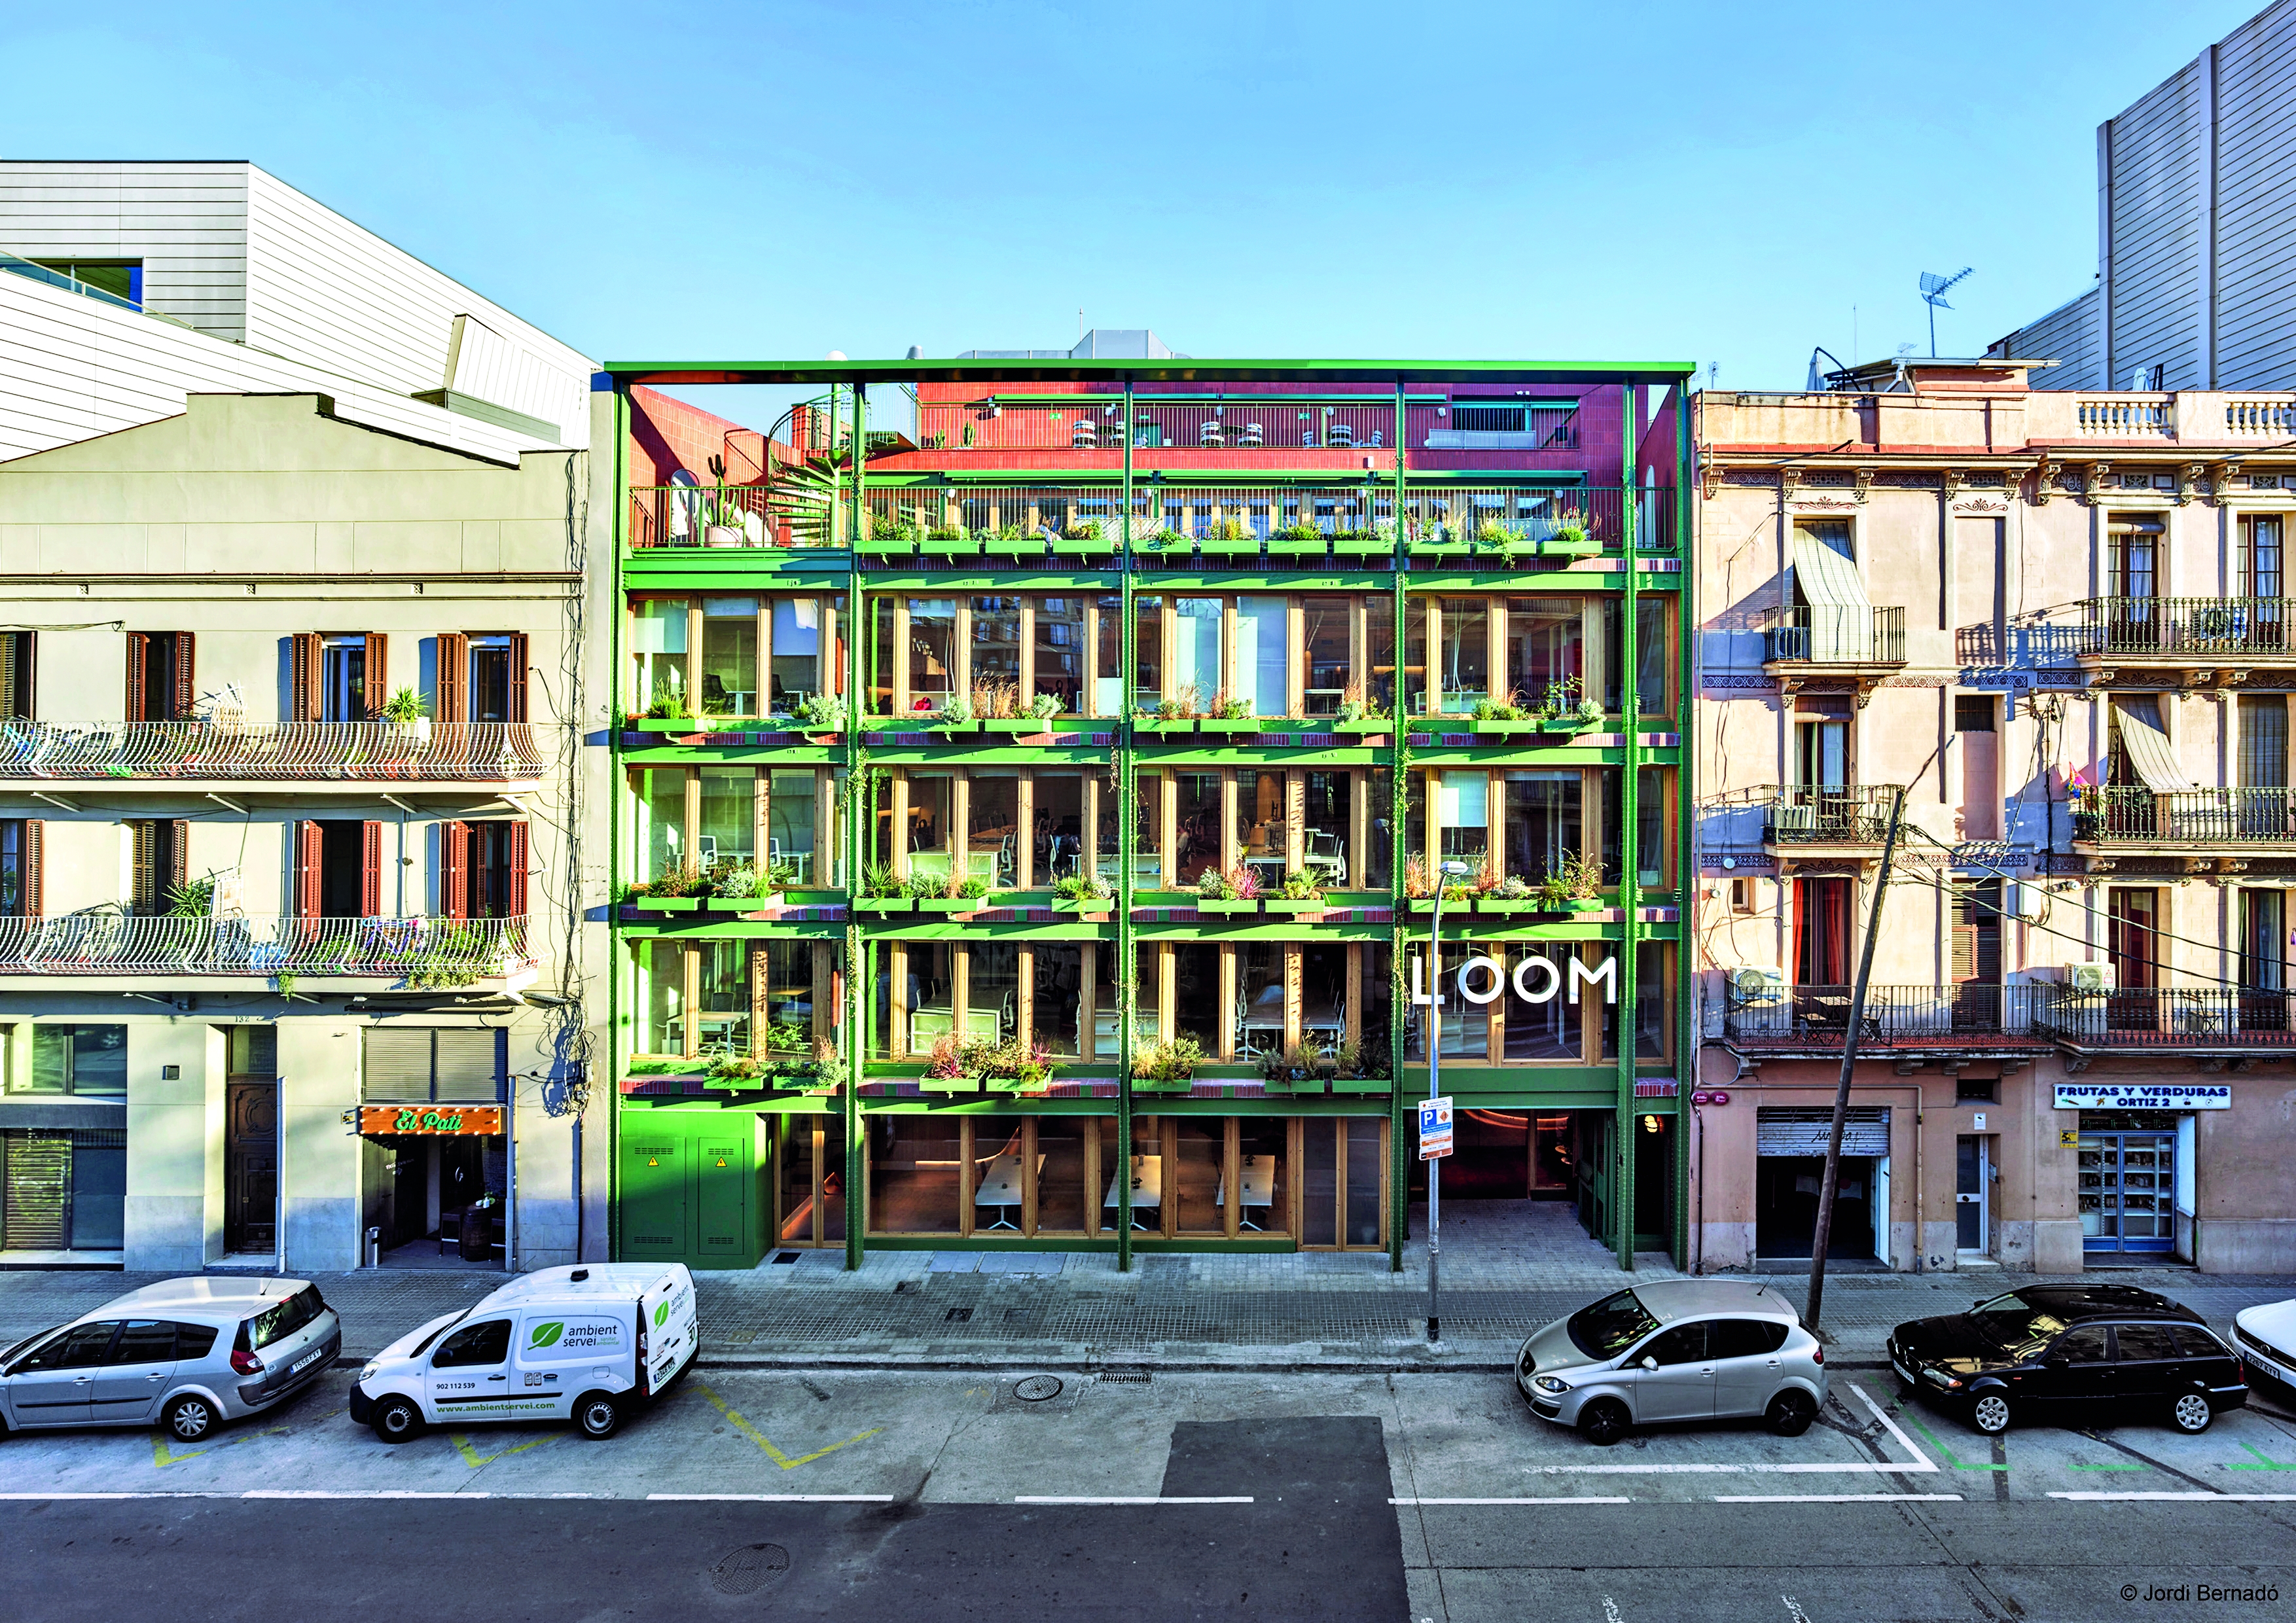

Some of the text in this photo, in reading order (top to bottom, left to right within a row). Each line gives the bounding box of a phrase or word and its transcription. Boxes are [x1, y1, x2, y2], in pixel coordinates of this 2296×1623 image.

[1412, 955, 1617, 1005] LOOM
[2057, 1087, 2228, 1097] FRUTAS Y VERDURAS
[2117, 1097, 2170, 1107] ORTIZ 2
[397, 1111, 463, 1131] El Pati
[1424, 1111, 1433, 1126] P
[568, 1325, 617, 1336] ambient
[563, 1336, 596, 1347] servei
[437, 1402, 556, 1413] www.ambientservei.com
